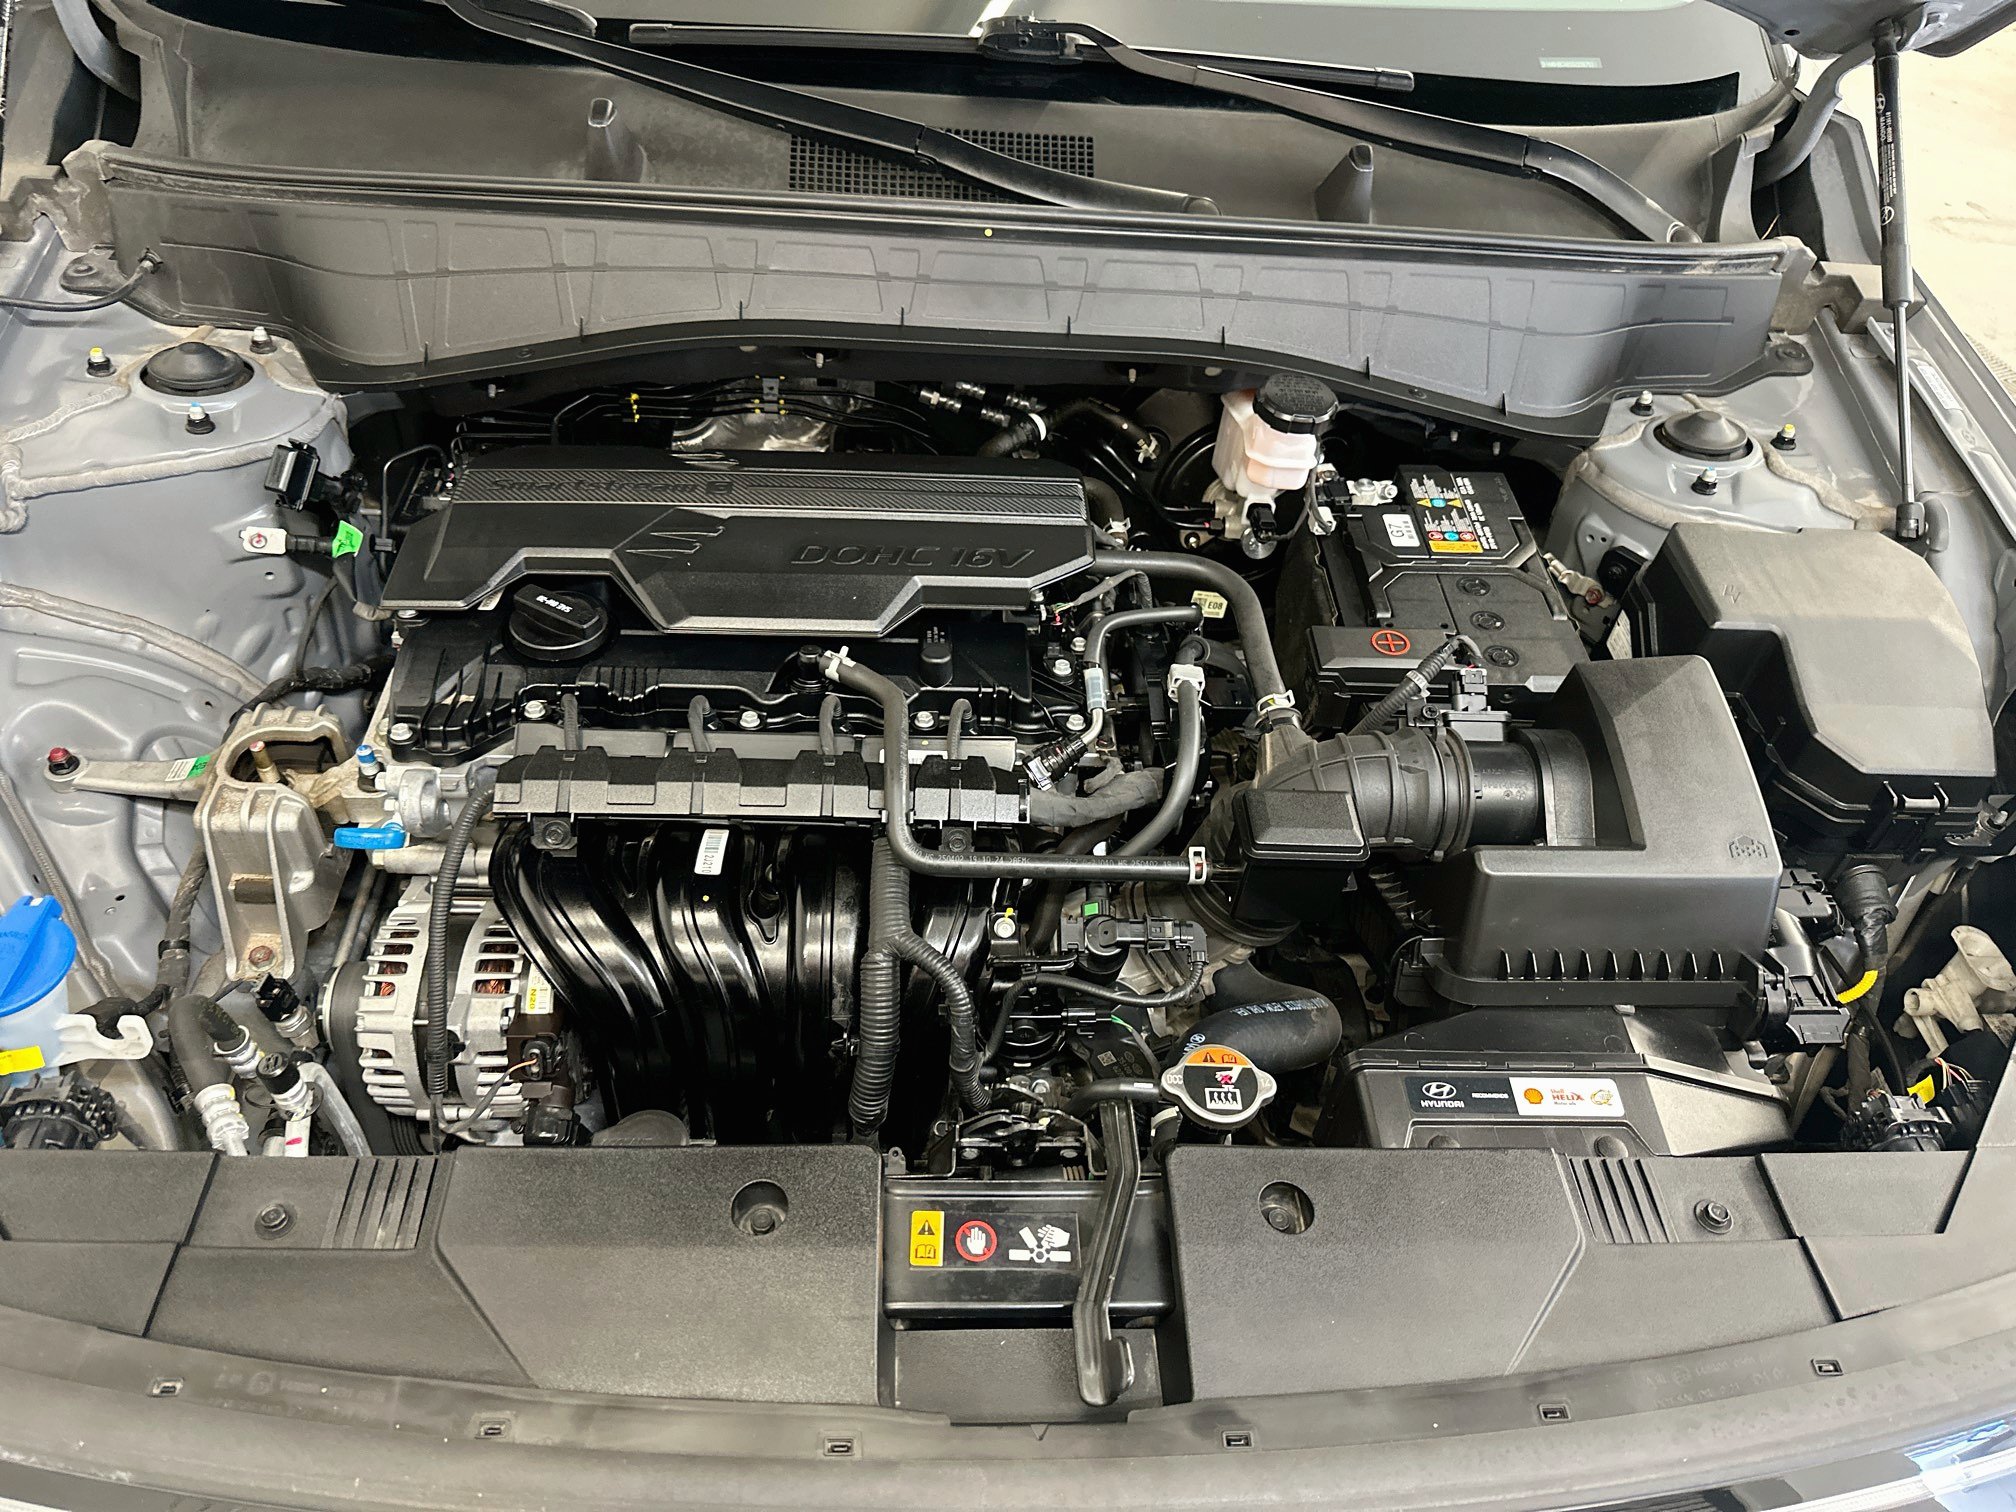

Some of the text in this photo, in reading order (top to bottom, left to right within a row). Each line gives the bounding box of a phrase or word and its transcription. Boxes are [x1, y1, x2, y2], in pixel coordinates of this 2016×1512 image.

[486, 478, 699, 493] Smartstream
[791, 545, 1035, 569] DOHC 16V
[1207, 601, 1224, 610] E08
[937, 854, 964, 863] 250402
[1552, 1092, 1584, 1101] HELIX
[1420, 1100, 1465, 1108] HYUNDAI
